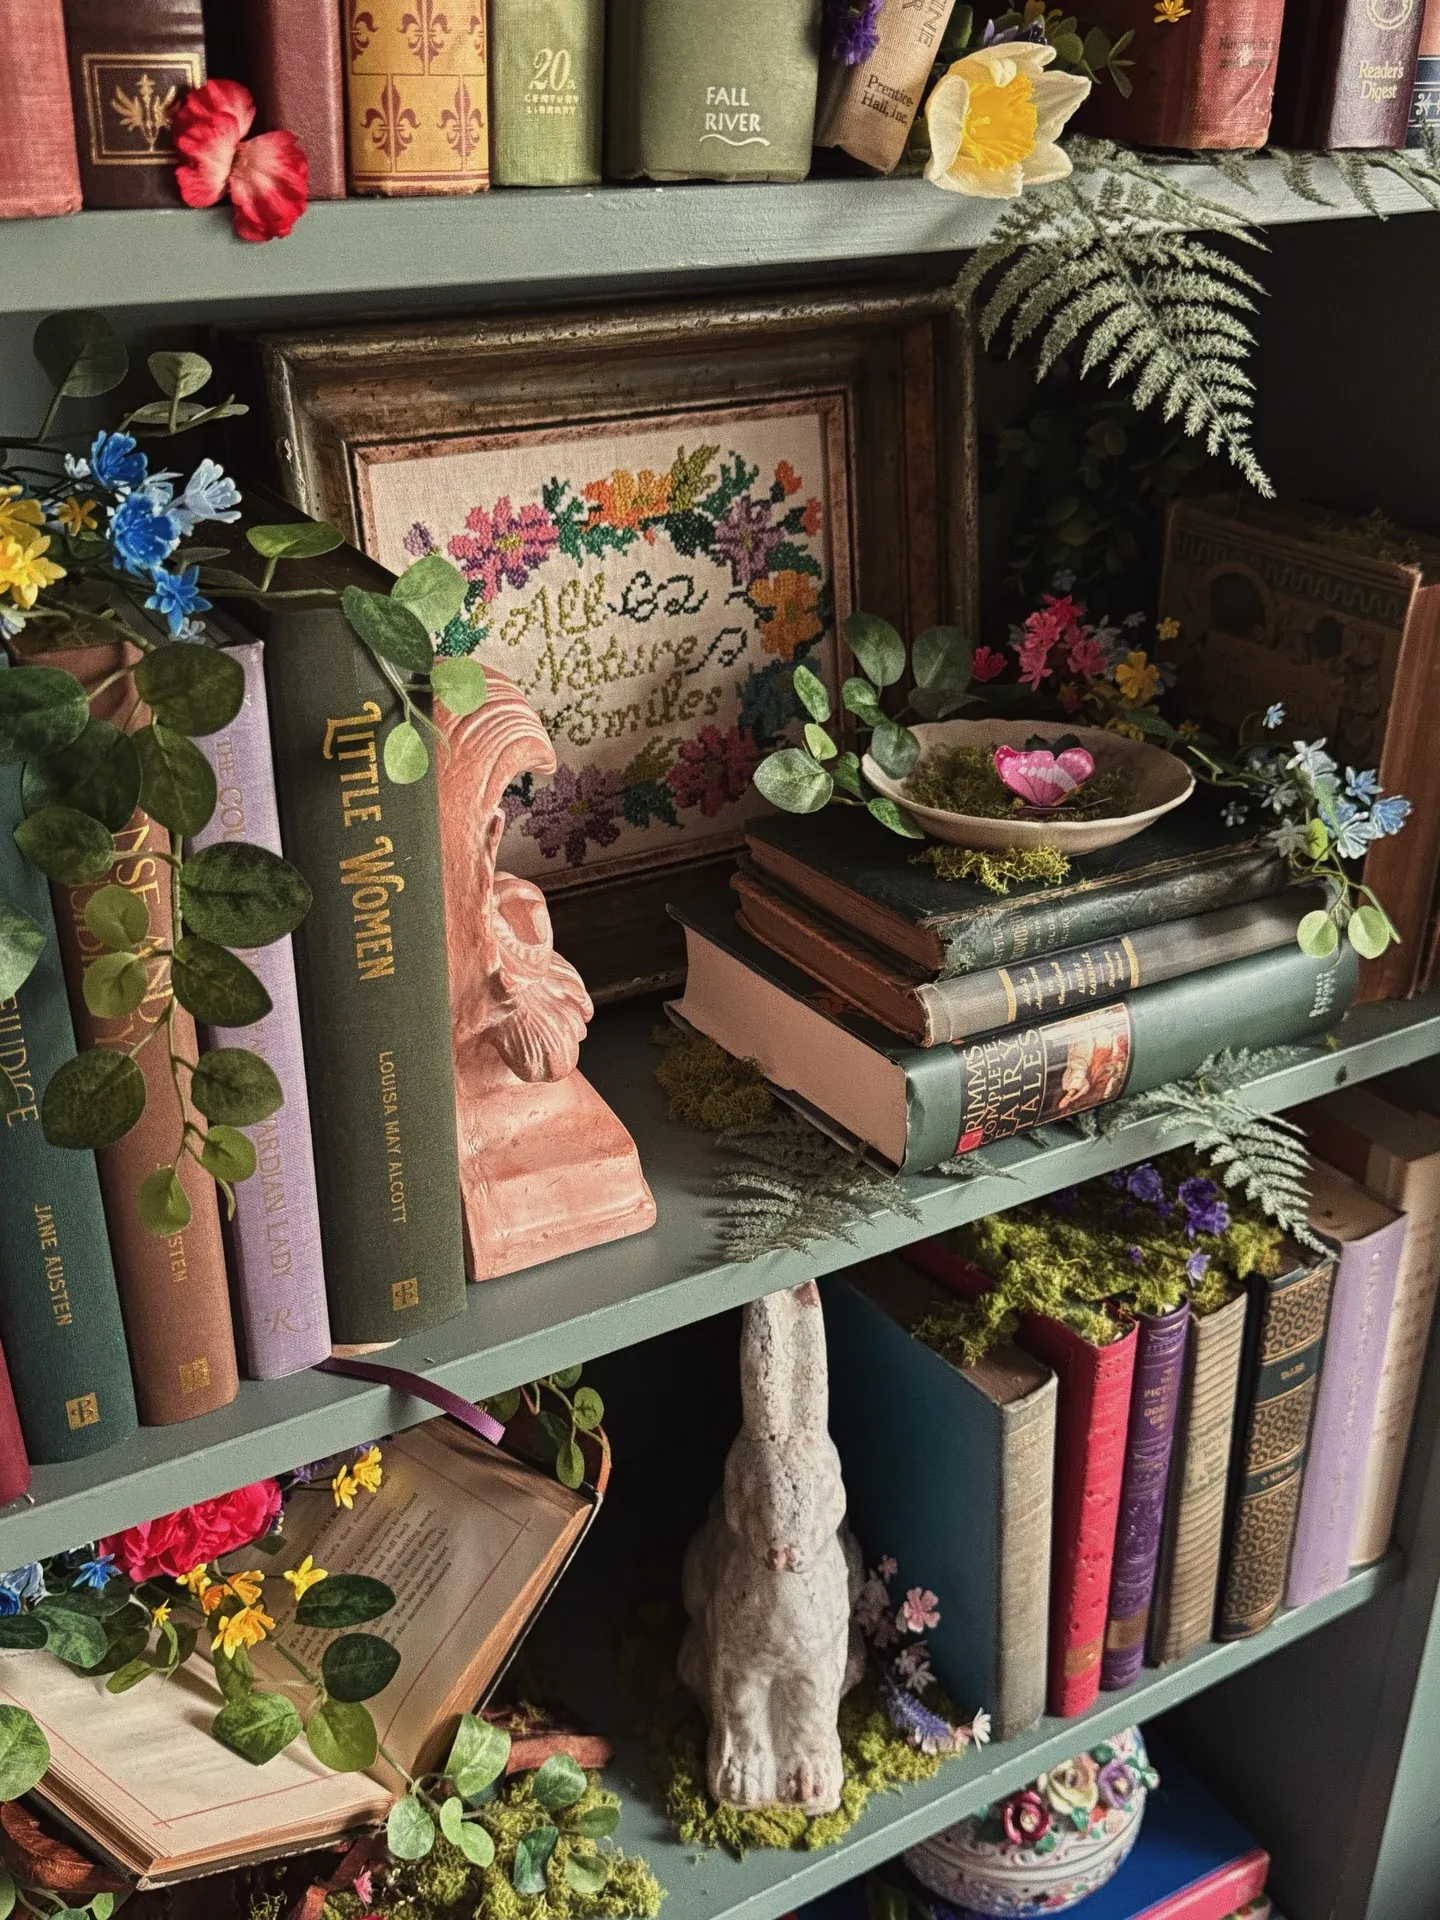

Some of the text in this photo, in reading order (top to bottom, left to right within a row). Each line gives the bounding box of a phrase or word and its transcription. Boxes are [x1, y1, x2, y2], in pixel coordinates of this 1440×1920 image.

[524, 93, 579, 104] CENTURY
[706, 87, 749, 107] FALL
[1358, 60, 1404, 80] Reader's
[1360, 80, 1398, 104] Digest
[526, 105, 576, 115] LIBRARY
[705, 112, 761, 132] RIVER
[861, 91, 889, 118] Hall,
[500, 572, 608, 646] All
[517, 634, 698, 694] Nature
[566, 670, 722, 746] Smiles
[216, 737, 234, 778] THE
[113, 812, 161, 905] NSE
[323, 701, 405, 981] LITTLE WOMEN
[1073, 962, 1086, 994] LEWIS
[1081, 951, 1097, 996] CARROLL
[955, 1045, 987, 1154] GRIMM'S
[981, 1041, 1003, 1145] COMPLETE
[995, 1039, 1024, 1140] FAIRY
[1012, 1028, 1042, 1136] TALES
[379, 1050, 407, 1223] LOUISA MAY ALCOTT
[256, 1119, 289, 1215] ARDIAN
[34, 1203, 74, 1328] JANE AUSTEN
[168, 1230, 188, 1284] STEN
[266, 1221, 294, 1280] LADY
